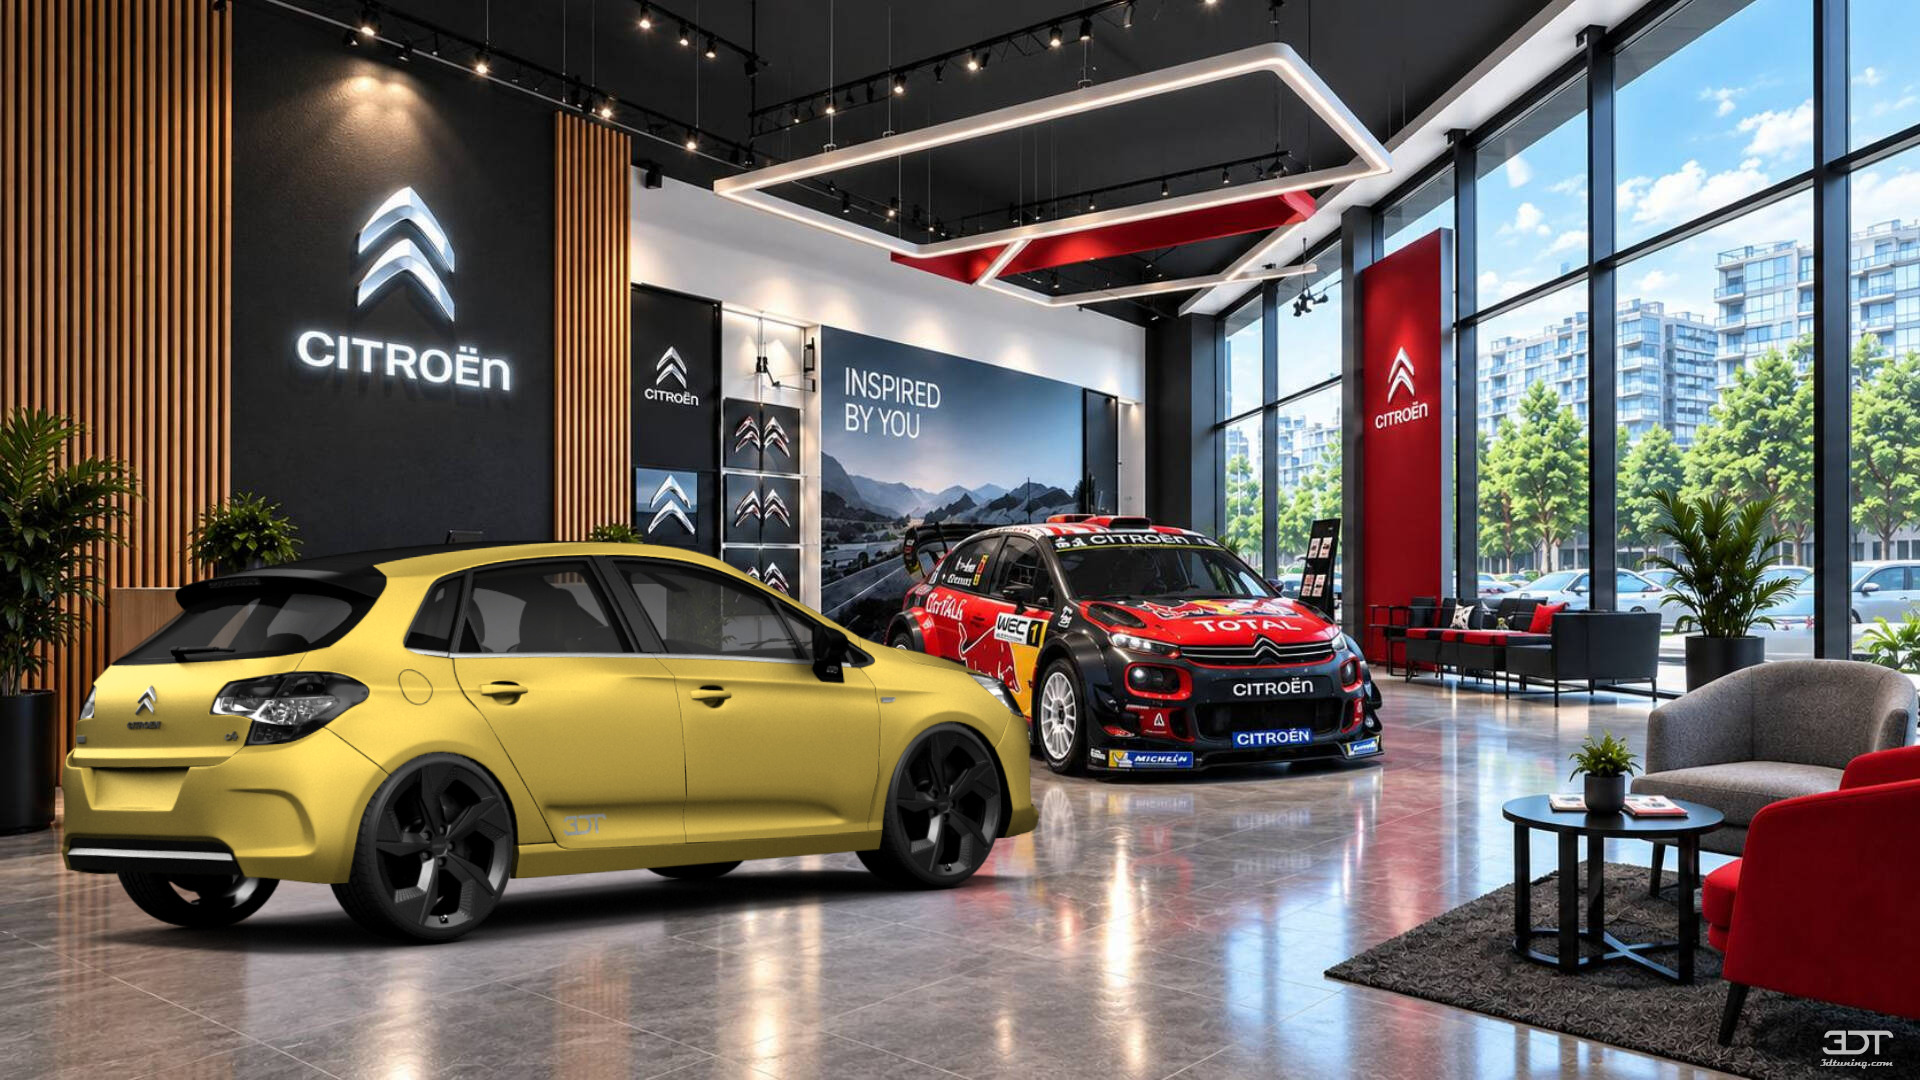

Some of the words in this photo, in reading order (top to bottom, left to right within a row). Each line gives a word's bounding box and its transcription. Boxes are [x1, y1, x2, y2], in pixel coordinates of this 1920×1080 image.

[845, 367, 941, 408] INSPIRED
[845, 403, 874, 433] BY
[878, 407, 920, 439] YOU
[1031, 623, 1039, 644] 1
[1193, 619, 1302, 632] TOTAL
[563, 813, 607, 836] 3DT
